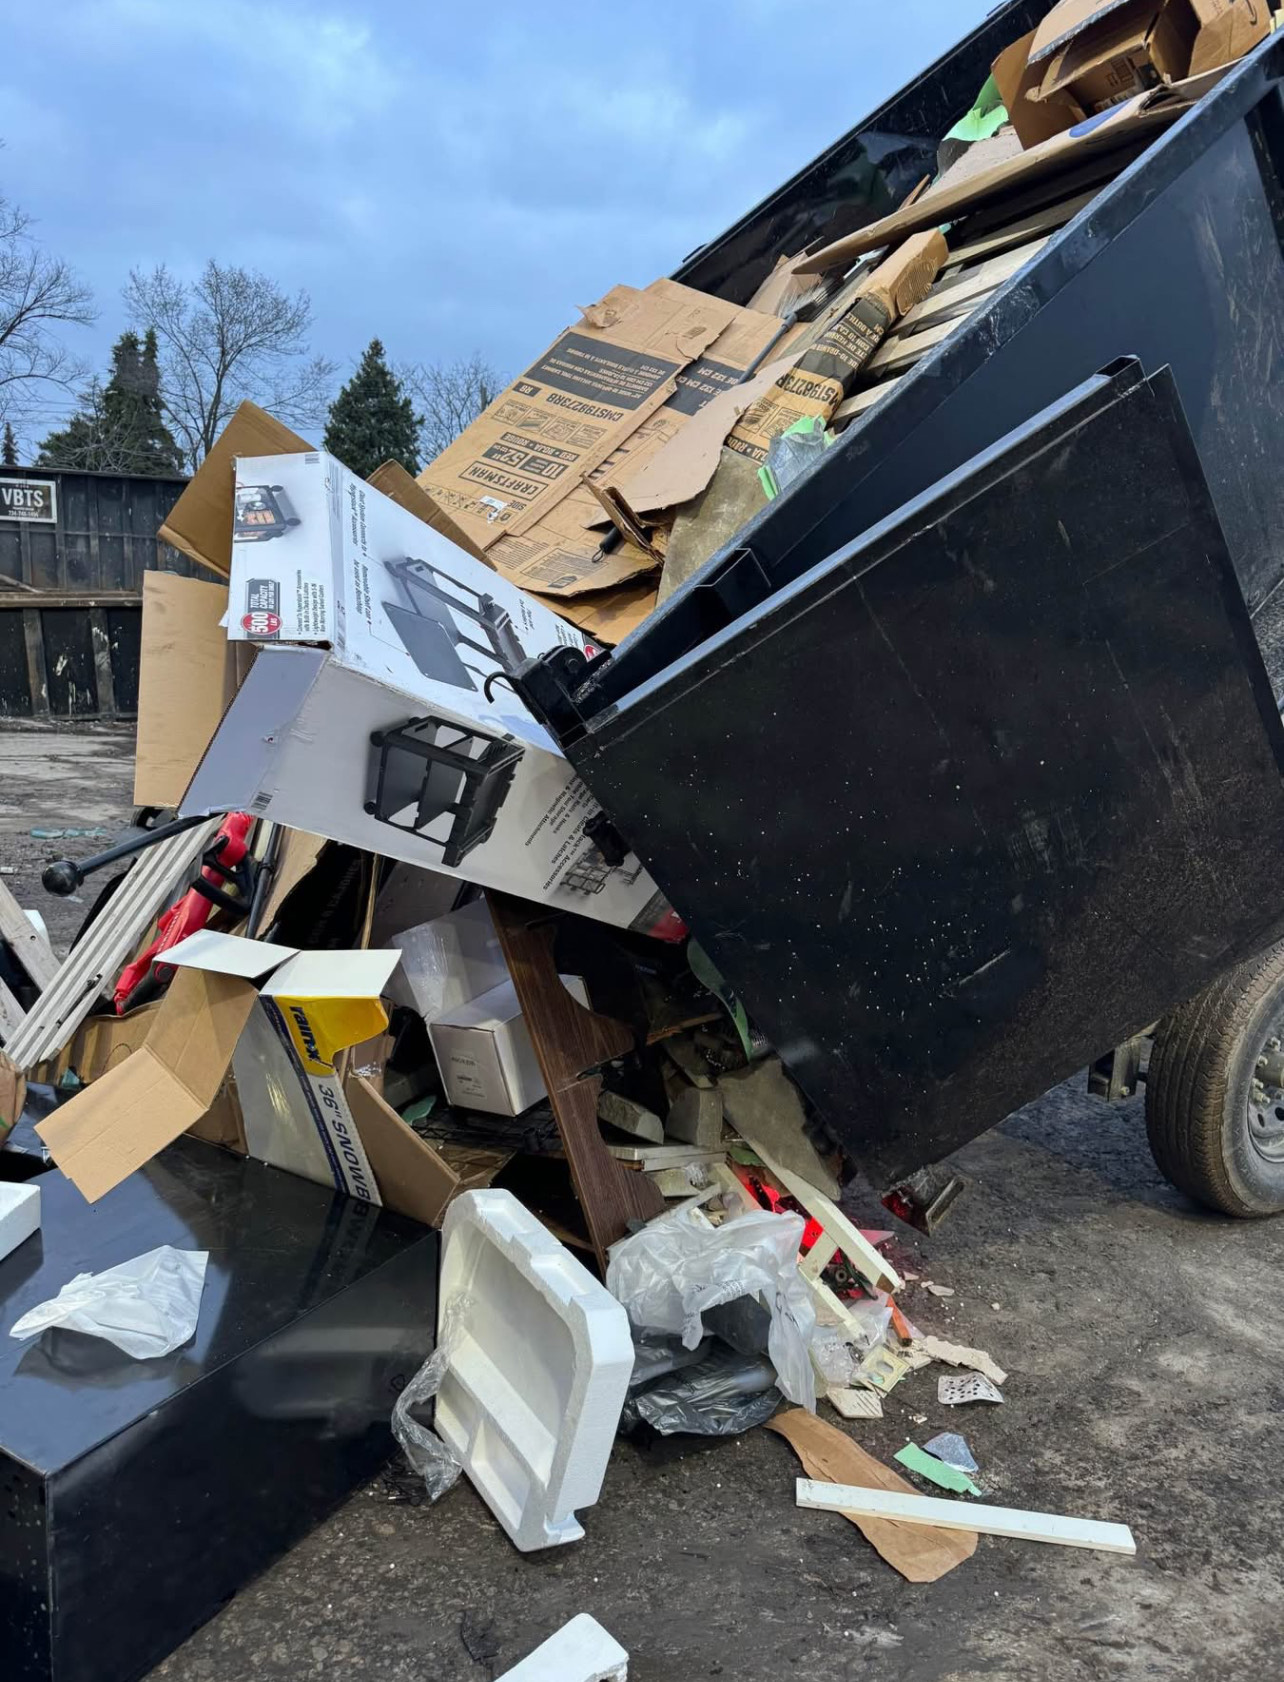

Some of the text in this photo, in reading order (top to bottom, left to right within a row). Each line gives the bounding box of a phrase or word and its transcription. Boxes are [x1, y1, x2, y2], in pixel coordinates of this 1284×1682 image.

[697, 366, 713, 377] CM
[710, 371, 727, 382] 132
[685, 377, 701, 389] CM
[698, 382, 715, 394] 132
[501, 433, 530, 446] ROUSE
[531, 443, 557, 454] ROJA
[490, 446, 568, 478] 10 52"
[466, 465, 540, 495] CRAFTSMAN
[1, 487, 44, 507] VBTS
[505, 499, 527, 510] SIDE
[250, 593, 259, 608] TOTAL
[259, 584, 267, 608] CAPACITY
[251, 612, 268, 632] 500
[269, 617, 277, 626] LBS
[548, 804, 566, 828] Storage
[524, 812, 550, 848] Attachments
[550, 839, 570, 865] Latches
[543, 854, 571, 890] Accessories
[319, 1084, 342, 1119] 36"
